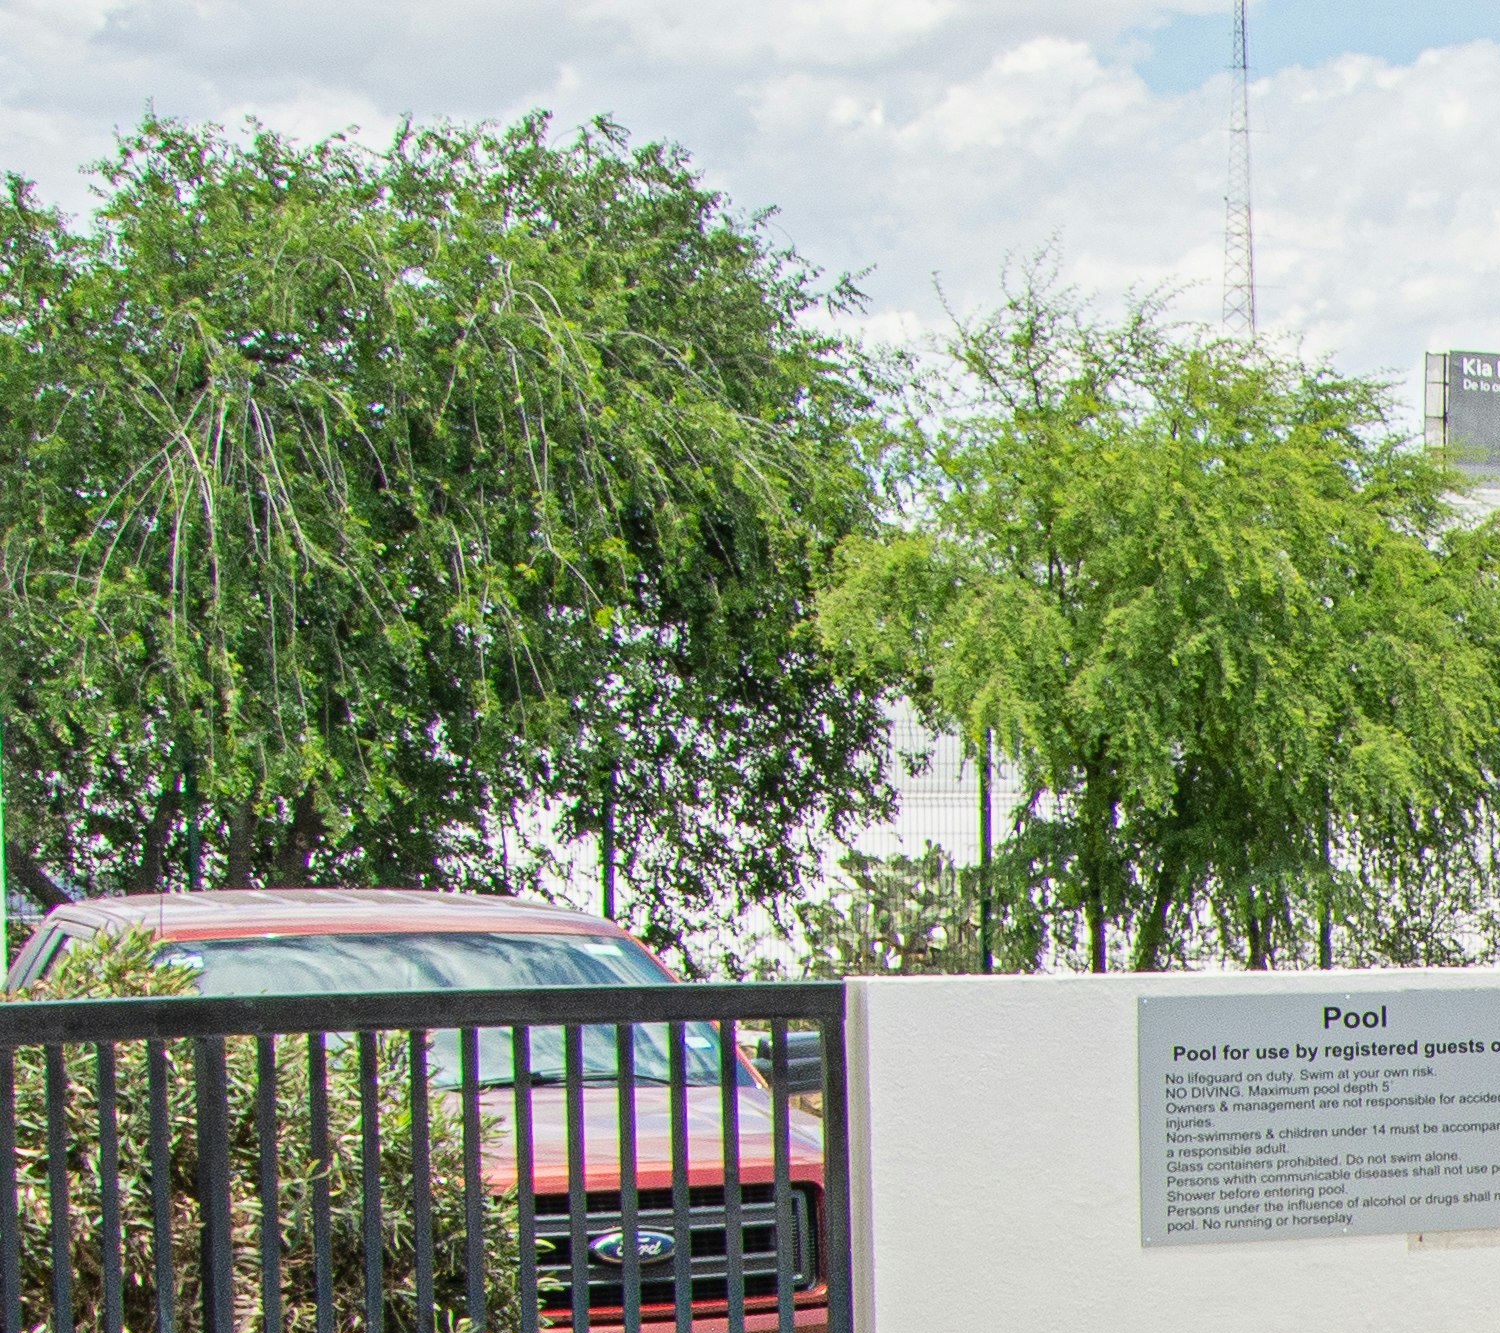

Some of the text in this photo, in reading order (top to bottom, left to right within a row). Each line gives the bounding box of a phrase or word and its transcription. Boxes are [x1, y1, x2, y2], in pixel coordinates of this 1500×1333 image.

[1463, 358, 1492, 377] Kia
[1463, 379, 1478, 391] De
[1480, 380, 1490, 392] lo
[1323, 1004, 1387, 1029] Pool
[1173, 1044, 1216, 1062] Pool
[1222, 1043, 1250, 1060] for
[1255, 1046, 1289, 1060] use
[1295, 1042, 1318, 1062] by
[1324, 1039, 1418, 1062] registered
[1424, 1038, 1484, 1058] guests
[1165, 1065, 1438, 1087] No lifeguard on duty. Swim at your own risk.
[1165, 1087, 1187, 1099] NO
[1191, 1085, 1243, 1099] DIVING.
[1248, 1083, 1309, 1097] Maximum
[1313, 1083, 1339, 1096] pool
[1343, 1081, 1378, 1095] depth
[1165, 1101, 1215, 1114] Owners
[1219, 1100, 1228, 1112] &
[1232, 1099, 1315, 1114] management
[1318, 1099, 1339, 1109] are
[1342, 1097, 1362, 1108] not
[1365, 1093, 1436, 1109] responsible
[1439, 1092, 1455, 1105] for
[1165, 1116, 1214, 1130] injuries.
[1166, 1128, 1261, 1144] Non-swimmers
[1265, 1128, 1274, 1139] &
[1278, 1126, 1327, 1139] children
[1331, 1124, 1367, 1137] under
[1371, 1124, 1386, 1135] 14
[1389, 1123, 1419, 1135] must
[1423, 1122, 1438, 1134] be
[1166, 1142, 1290, 1159] a responsible adult.
[1166, 1149, 1460, 1173] Glass containers prohibited. Do not swim alone.
[1166, 1174, 1219, 1188] Persons
[1223, 1173, 1256, 1185] whith
[1260, 1168, 1350, 1184] communicable
[1354, 1165, 1408, 1179] diseases
[1412, 1164, 1440, 1177] shall
[1444, 1164, 1462, 1175] not
[1466, 1164, 1488, 1174] use
[1166, 1183, 1350, 1205] Shower before entering pool.
[1167, 1203, 1219, 1217] Persons
[1223, 1202, 1260, 1214] under
[1264, 1201, 1283, 1212] the
[1287, 1197, 1343, 1211] influence
[1346, 1196, 1359, 1208] of
[1362, 1194, 1405, 1208] alcohol
[1409, 1195, 1422, 1205] or
[1425, 1191, 1459, 1206] drugs
[1462, 1190, 1490, 1203] shall
[1166, 1219, 1200, 1234] pool.
[1202, 1217, 1221, 1230] No
[1224, 1215, 1272, 1232] running
[1275, 1216, 1289, 1226] or
